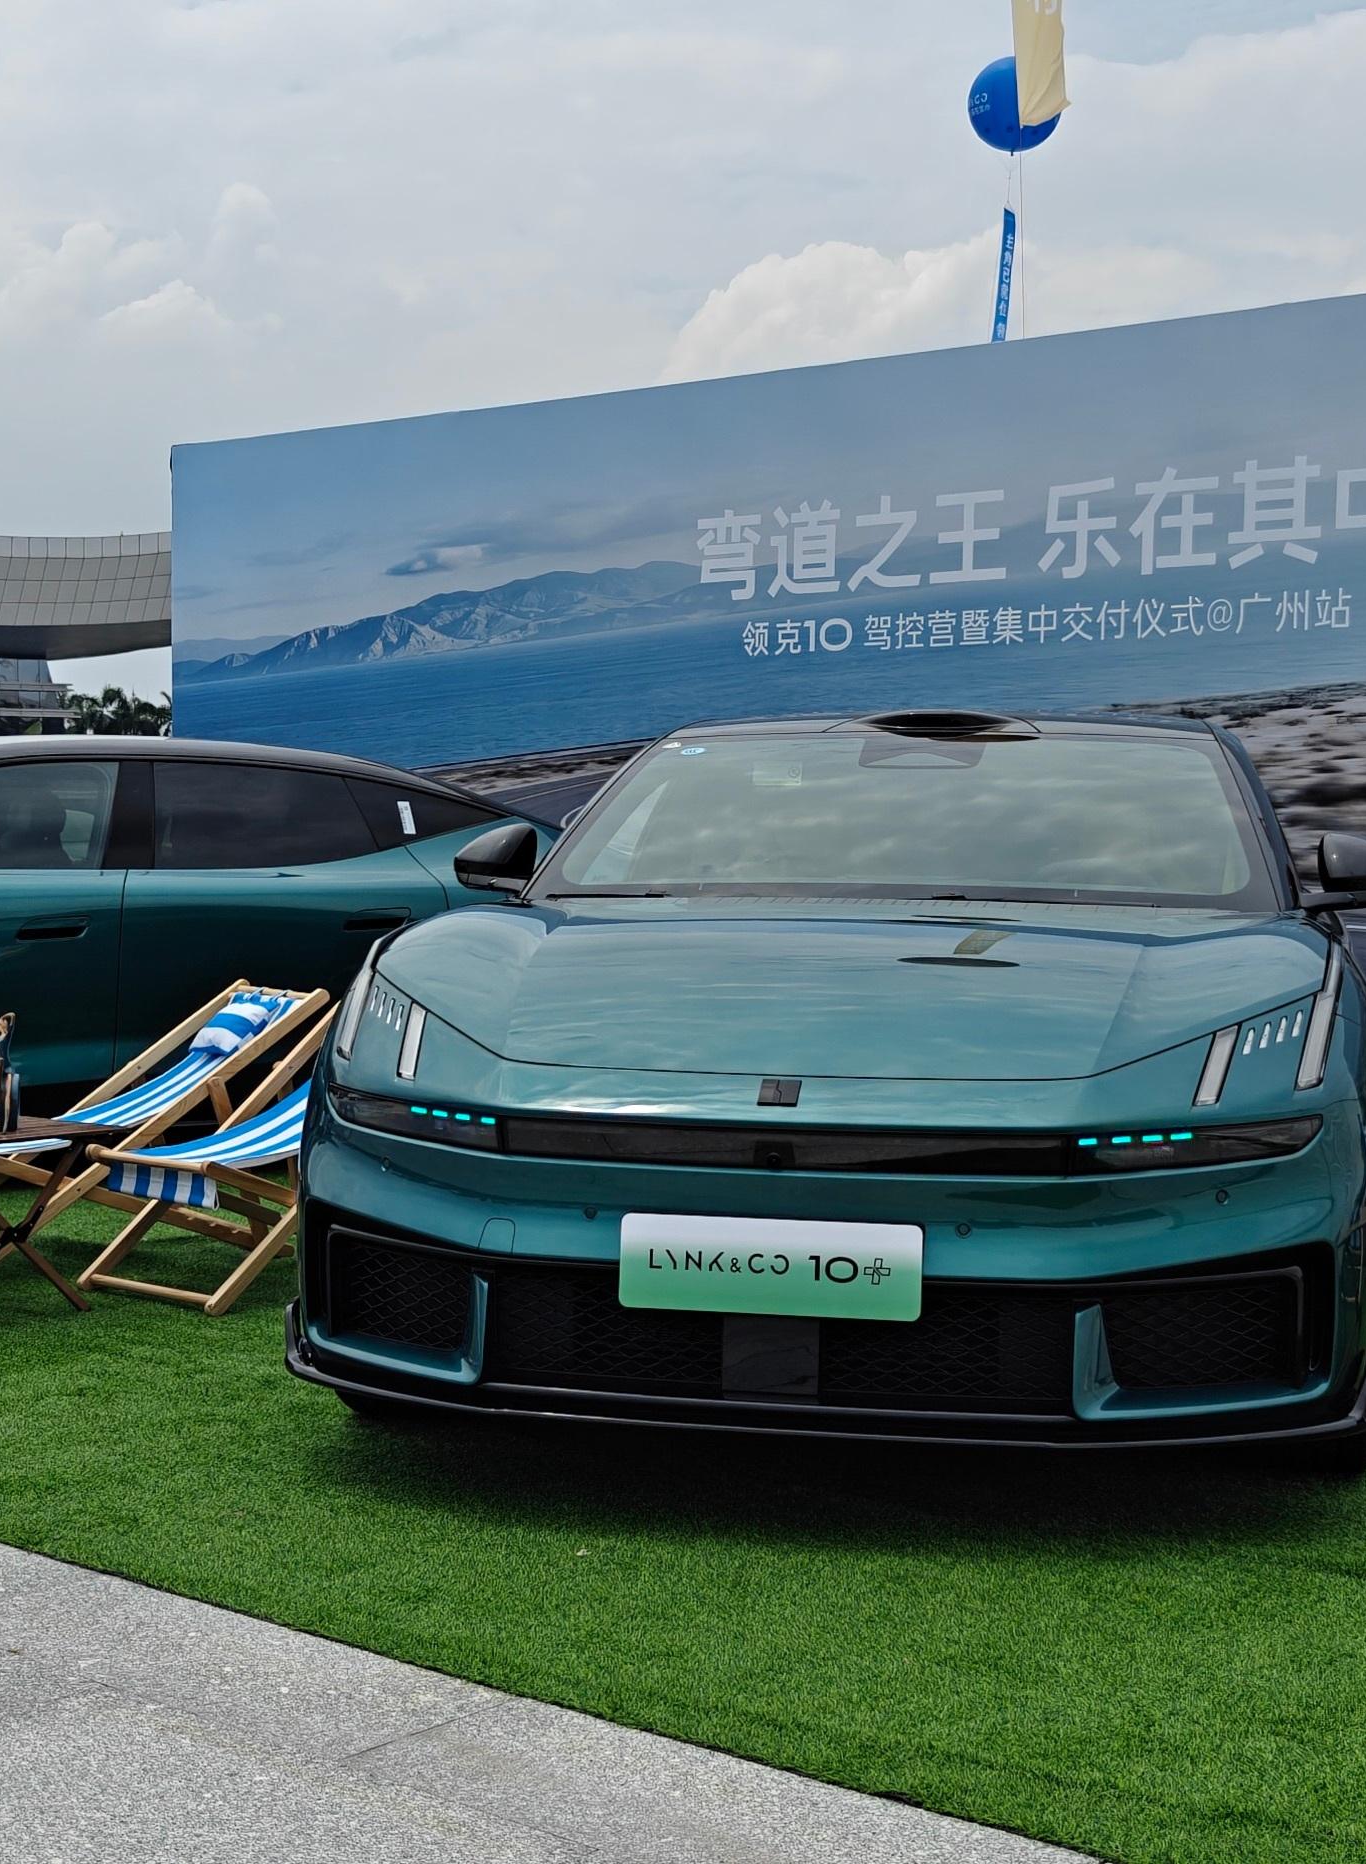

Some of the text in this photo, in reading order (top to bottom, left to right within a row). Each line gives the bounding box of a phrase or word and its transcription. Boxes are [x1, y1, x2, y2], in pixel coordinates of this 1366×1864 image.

[695, 488, 1008, 601] 弯道之王
[741, 586, 1353, 657] 领克10 驾控营暨集中交付仪式@广州站
[648, 1248, 790, 1275] LYNK&CO
